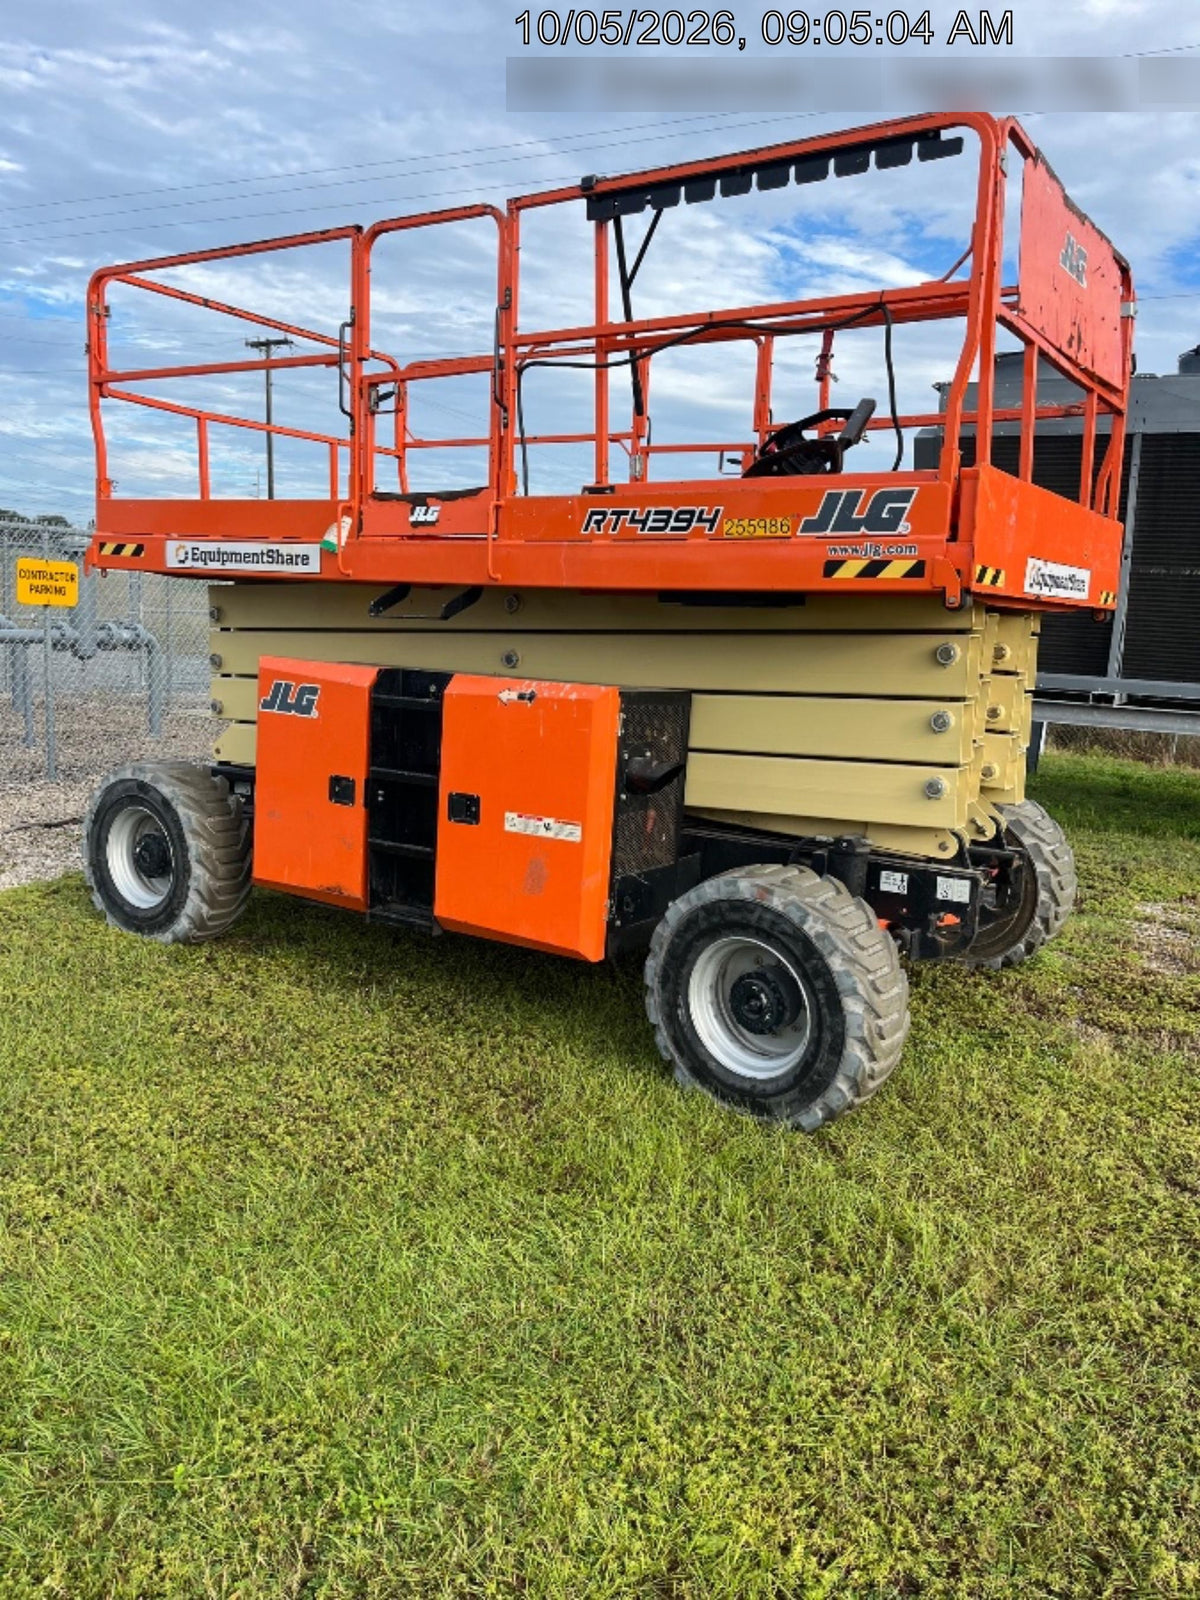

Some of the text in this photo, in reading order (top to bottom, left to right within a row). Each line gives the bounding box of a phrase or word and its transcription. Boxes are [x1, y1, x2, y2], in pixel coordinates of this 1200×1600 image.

[408, 506, 440, 521] JLG
[796, 487, 918, 535] JLG
[581, 506, 723, 534] RT4394
[724, 519, 791, 536] 255986
[190, 546, 311, 566] EquipmentShare
[827, 543, 917, 556] www.jlg.com
[18, 568, 77, 583] CONTRACTOR
[29, 583, 66, 596] PARKING
[259, 680, 321, 717] JLG
